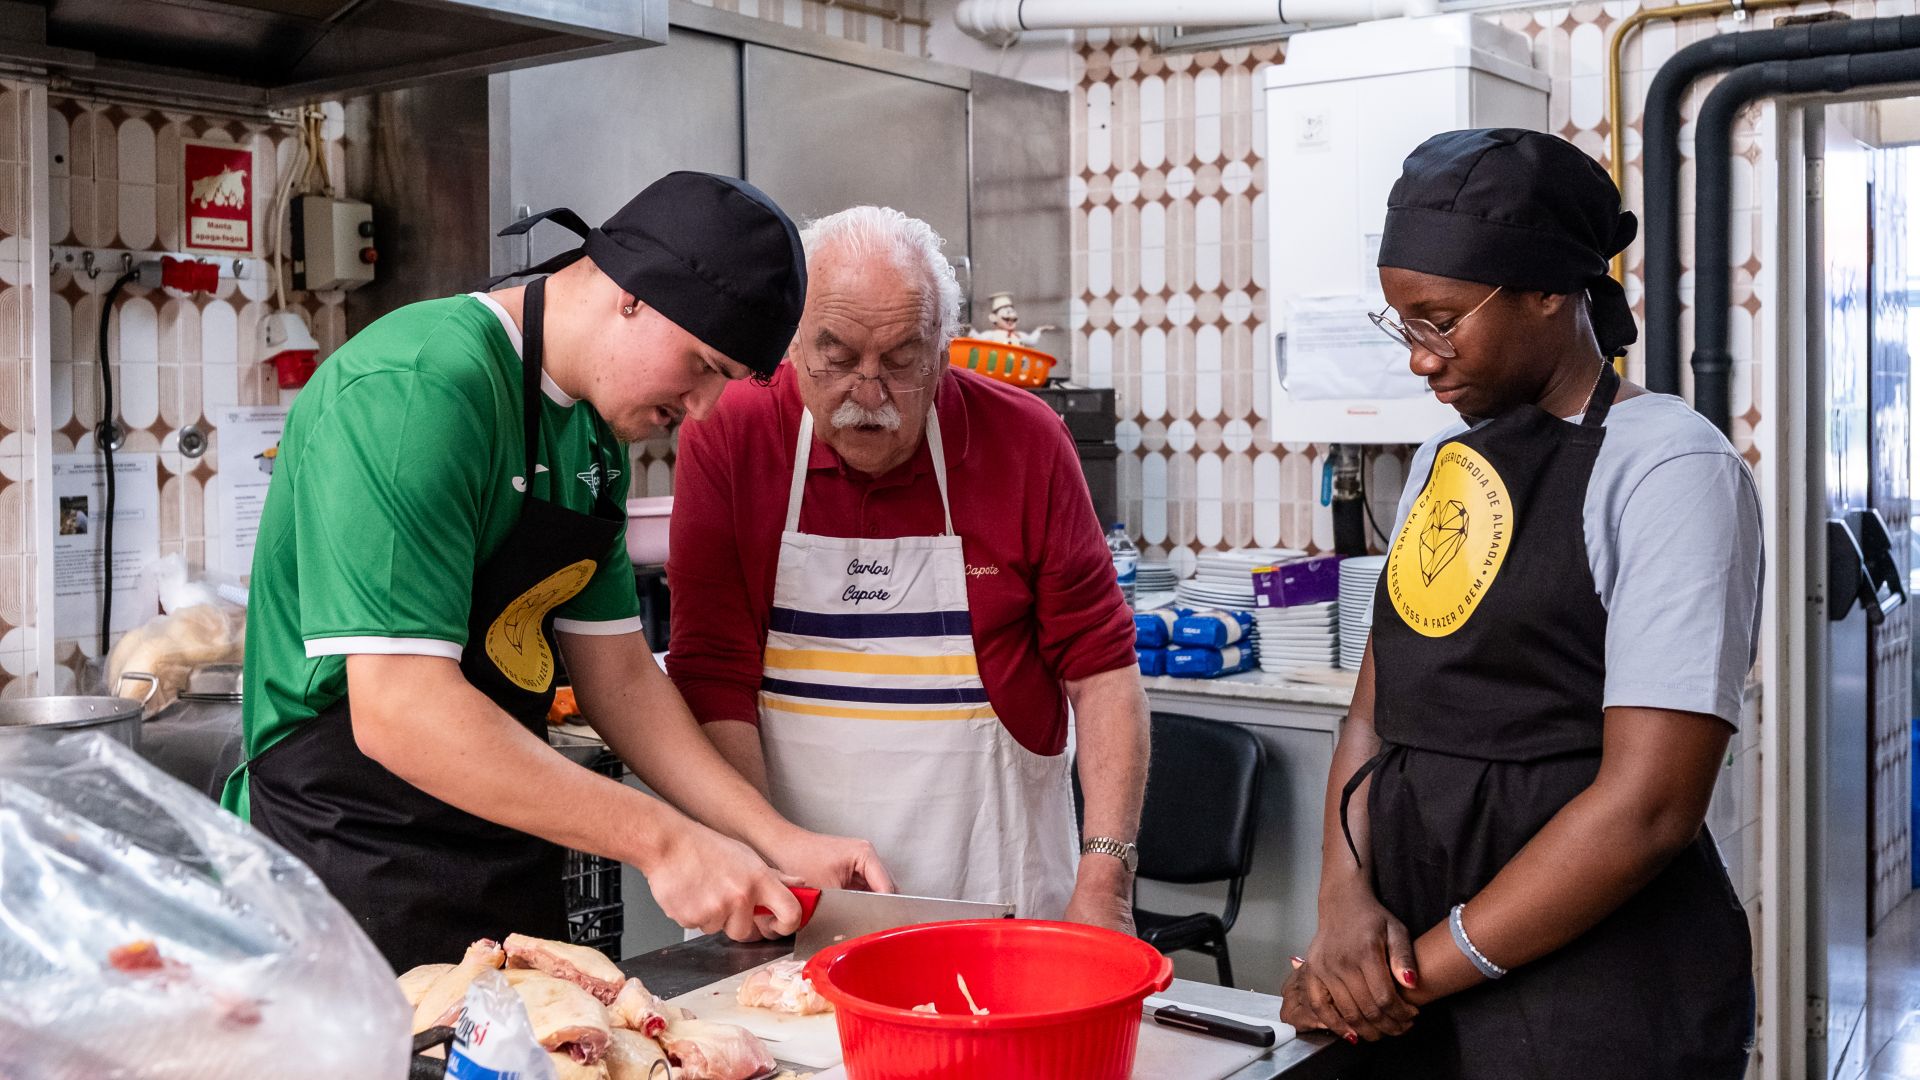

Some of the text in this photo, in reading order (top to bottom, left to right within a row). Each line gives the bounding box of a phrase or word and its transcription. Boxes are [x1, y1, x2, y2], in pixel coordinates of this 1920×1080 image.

[207, 222, 232, 230] Manta
[1440, 452, 1490, 488] MISERICÓRDIA
[1486, 491, 1500, 508] DE
[1397, 513, 1418, 550] SANTA
[1483, 514, 1504, 566] ALMADA
[847, 558, 891, 576] Carlos
[965, 563, 1000, 578] Capote
[842, 584, 891, 606] Capote
[1391, 564, 1483, 629] DESDE 1555 A FAZER O BEM
